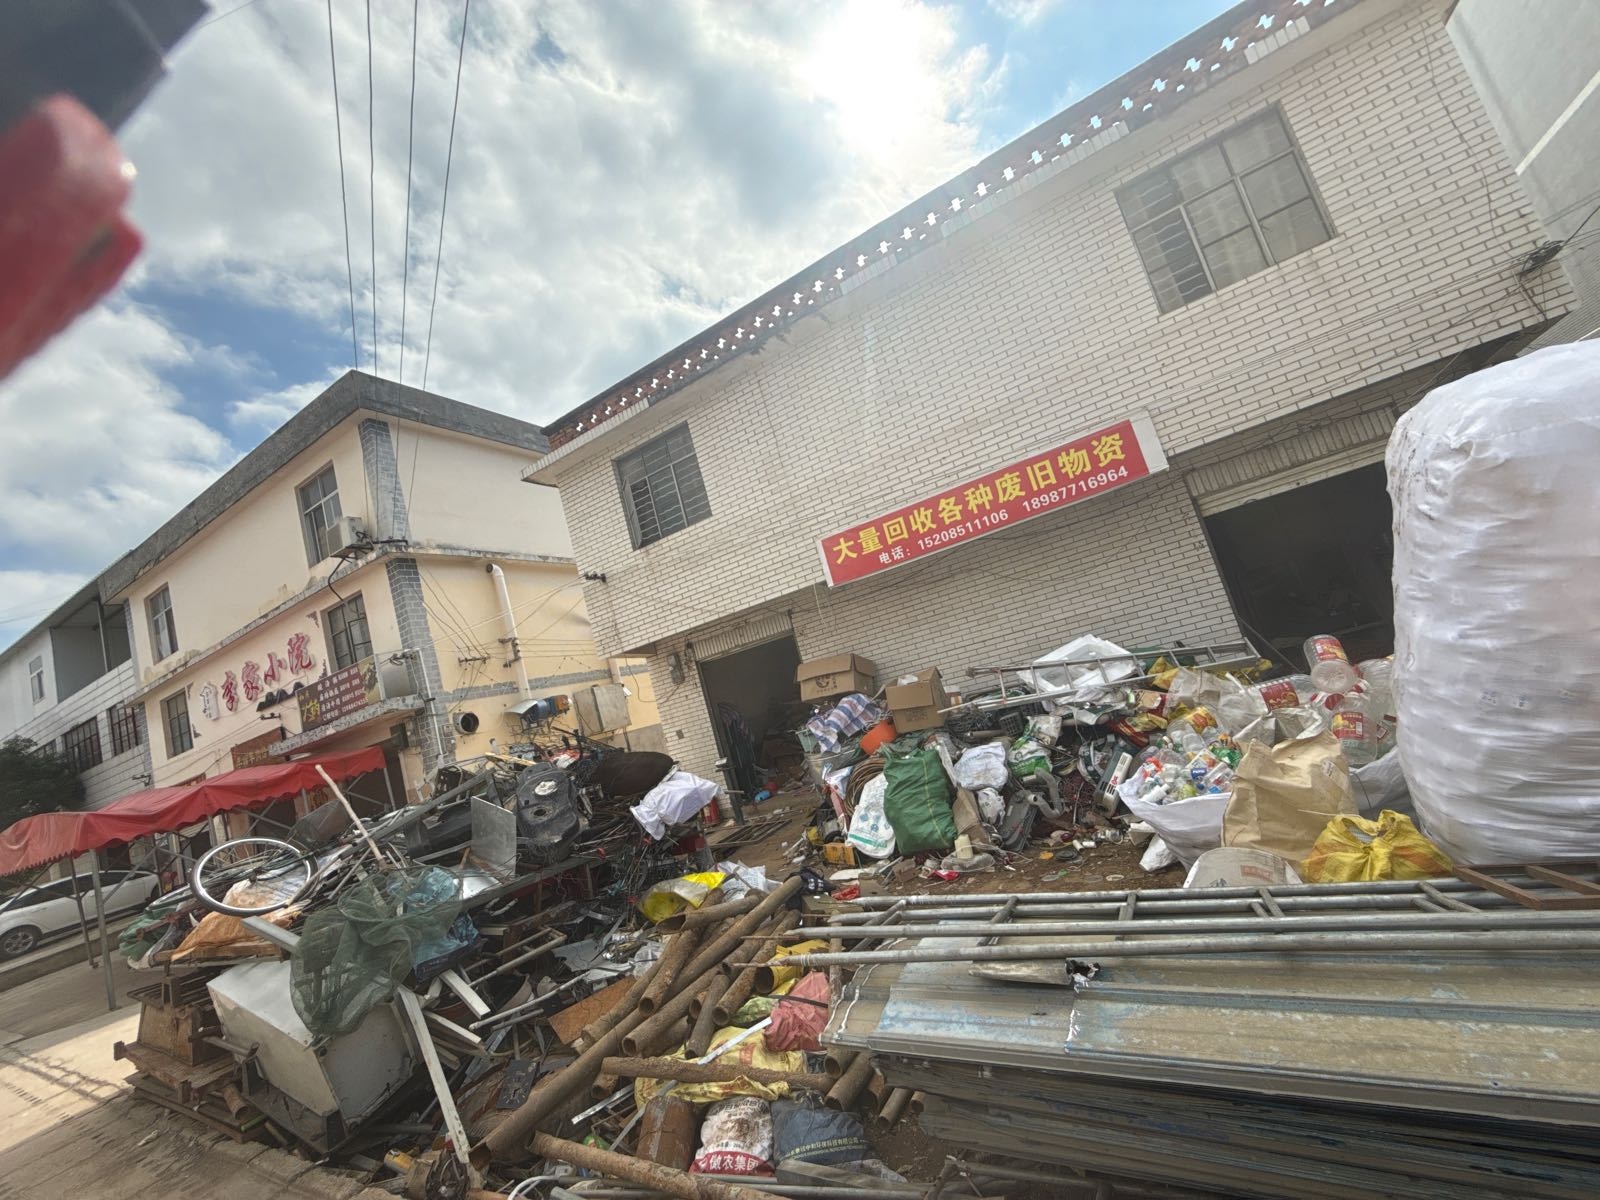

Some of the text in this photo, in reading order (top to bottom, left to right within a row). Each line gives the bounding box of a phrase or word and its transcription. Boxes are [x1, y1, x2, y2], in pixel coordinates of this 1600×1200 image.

[833, 432, 1127, 564] 大量回收各种废旧物资
[917, 508, 1009, 551] 15208511106
[1022, 466, 1129, 513] 18987716964
[709, 1153, 760, 1172] 傲农集团
